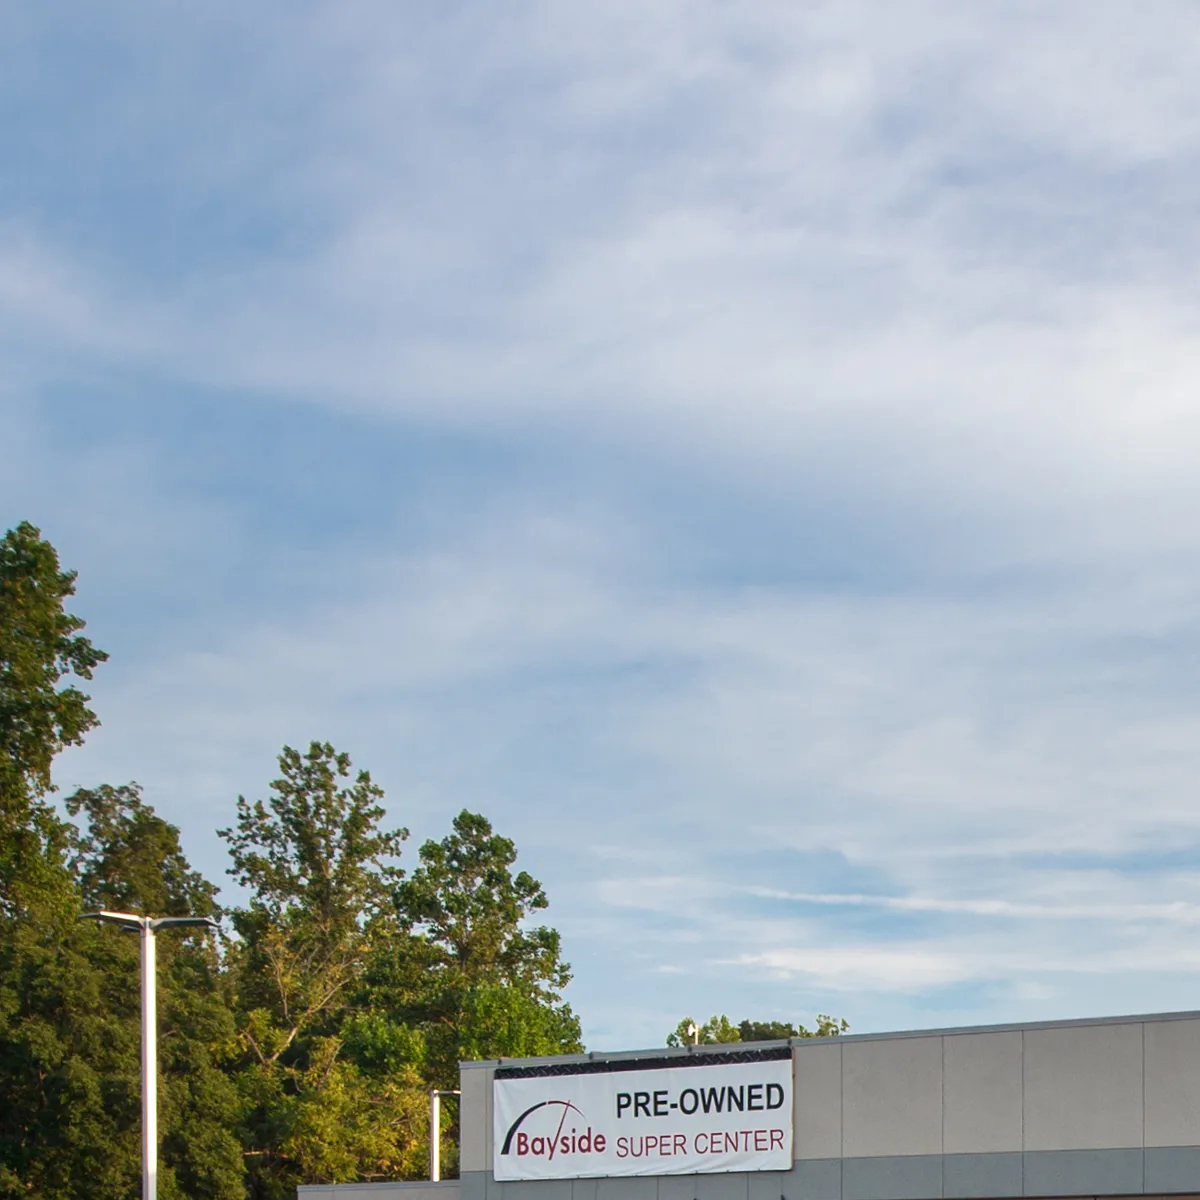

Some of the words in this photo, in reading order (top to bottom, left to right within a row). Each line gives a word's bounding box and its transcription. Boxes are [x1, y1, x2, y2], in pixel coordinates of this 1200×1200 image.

[616, 1083, 785, 1118] PRE-OWNED
[516, 1127, 606, 1160] Bayside
[616, 1134, 687, 1158] SUPER
[694, 1129, 784, 1153] CENTER
